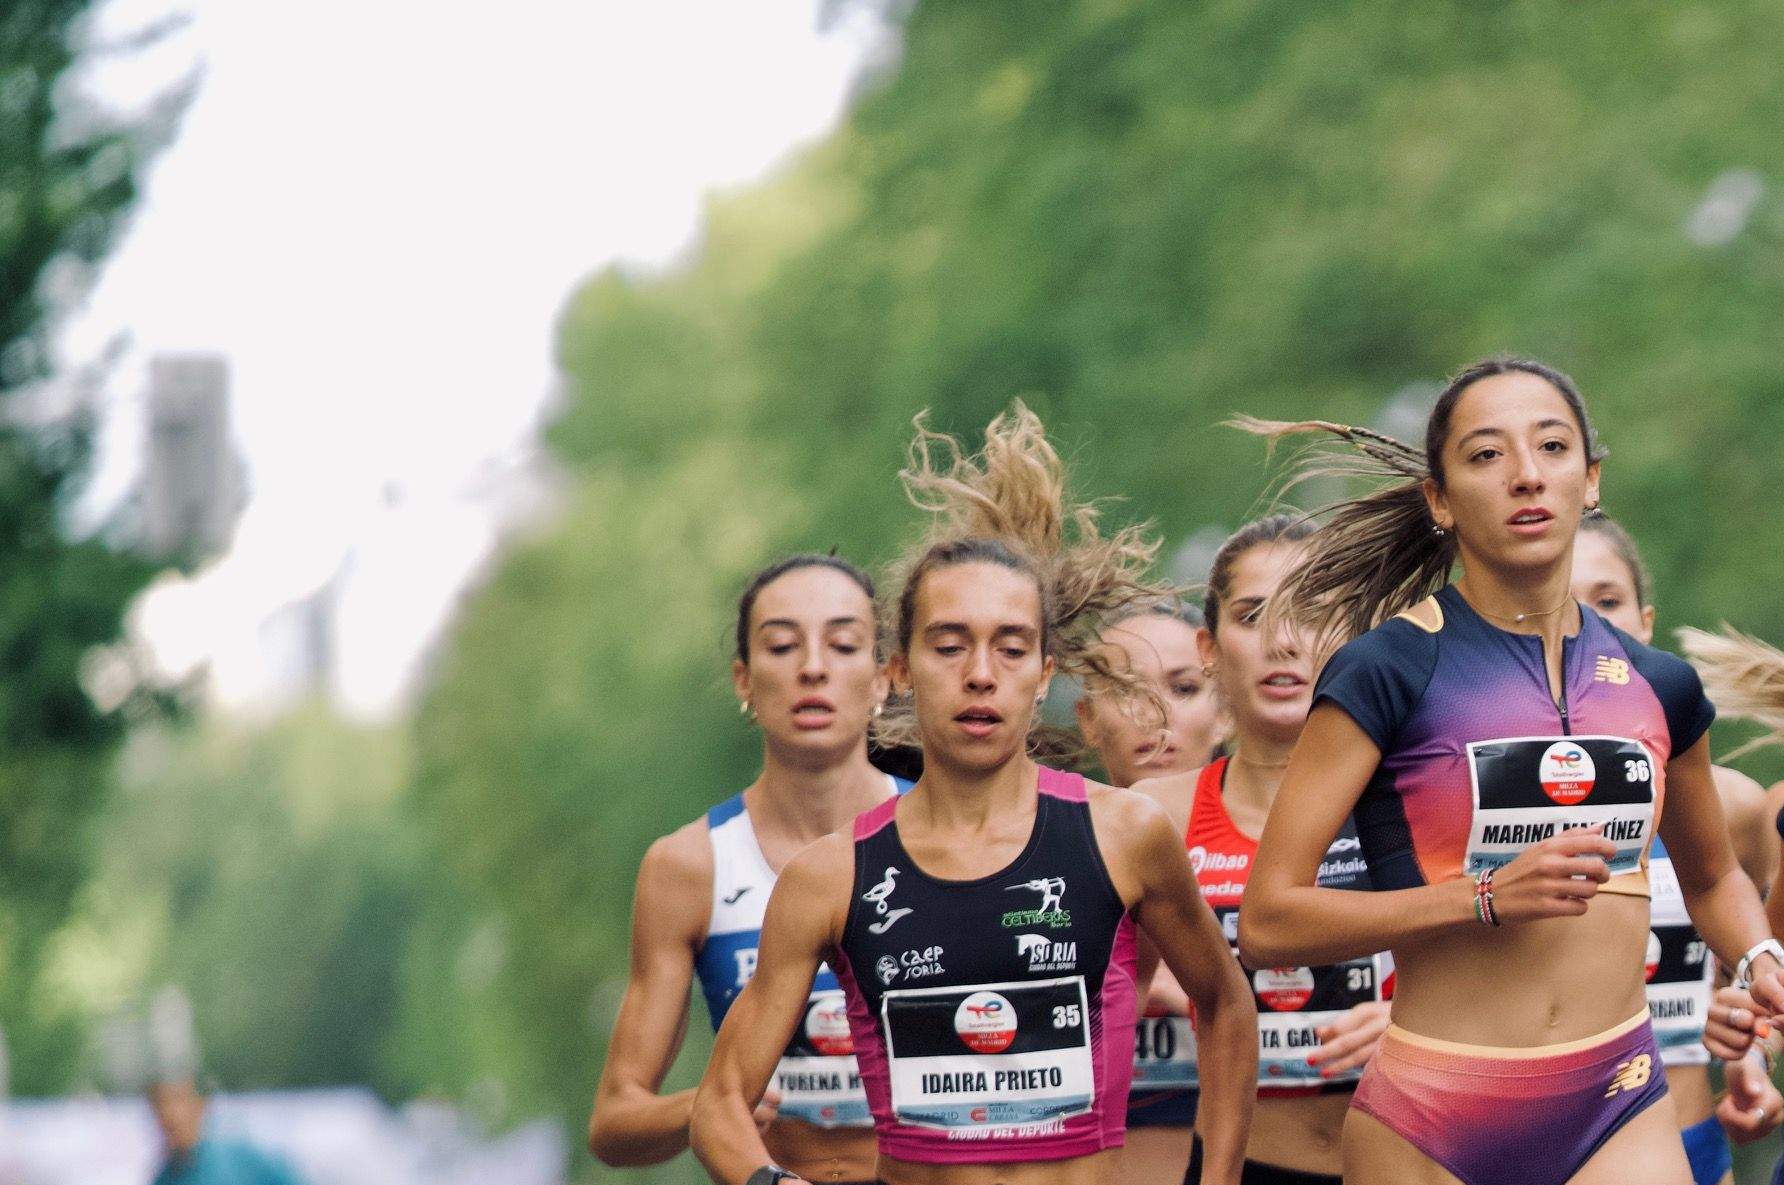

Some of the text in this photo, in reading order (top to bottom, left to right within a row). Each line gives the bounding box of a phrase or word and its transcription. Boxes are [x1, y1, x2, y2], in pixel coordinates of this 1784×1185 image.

[1624, 760, 1649, 783] 36
[1482, 824, 1555, 844] MARINA
[1347, 967, 1372, 990] 31
[1052, 1004, 1081, 1029] 35
[922, 1067, 1062, 1094] IDAIRA PRIETO
